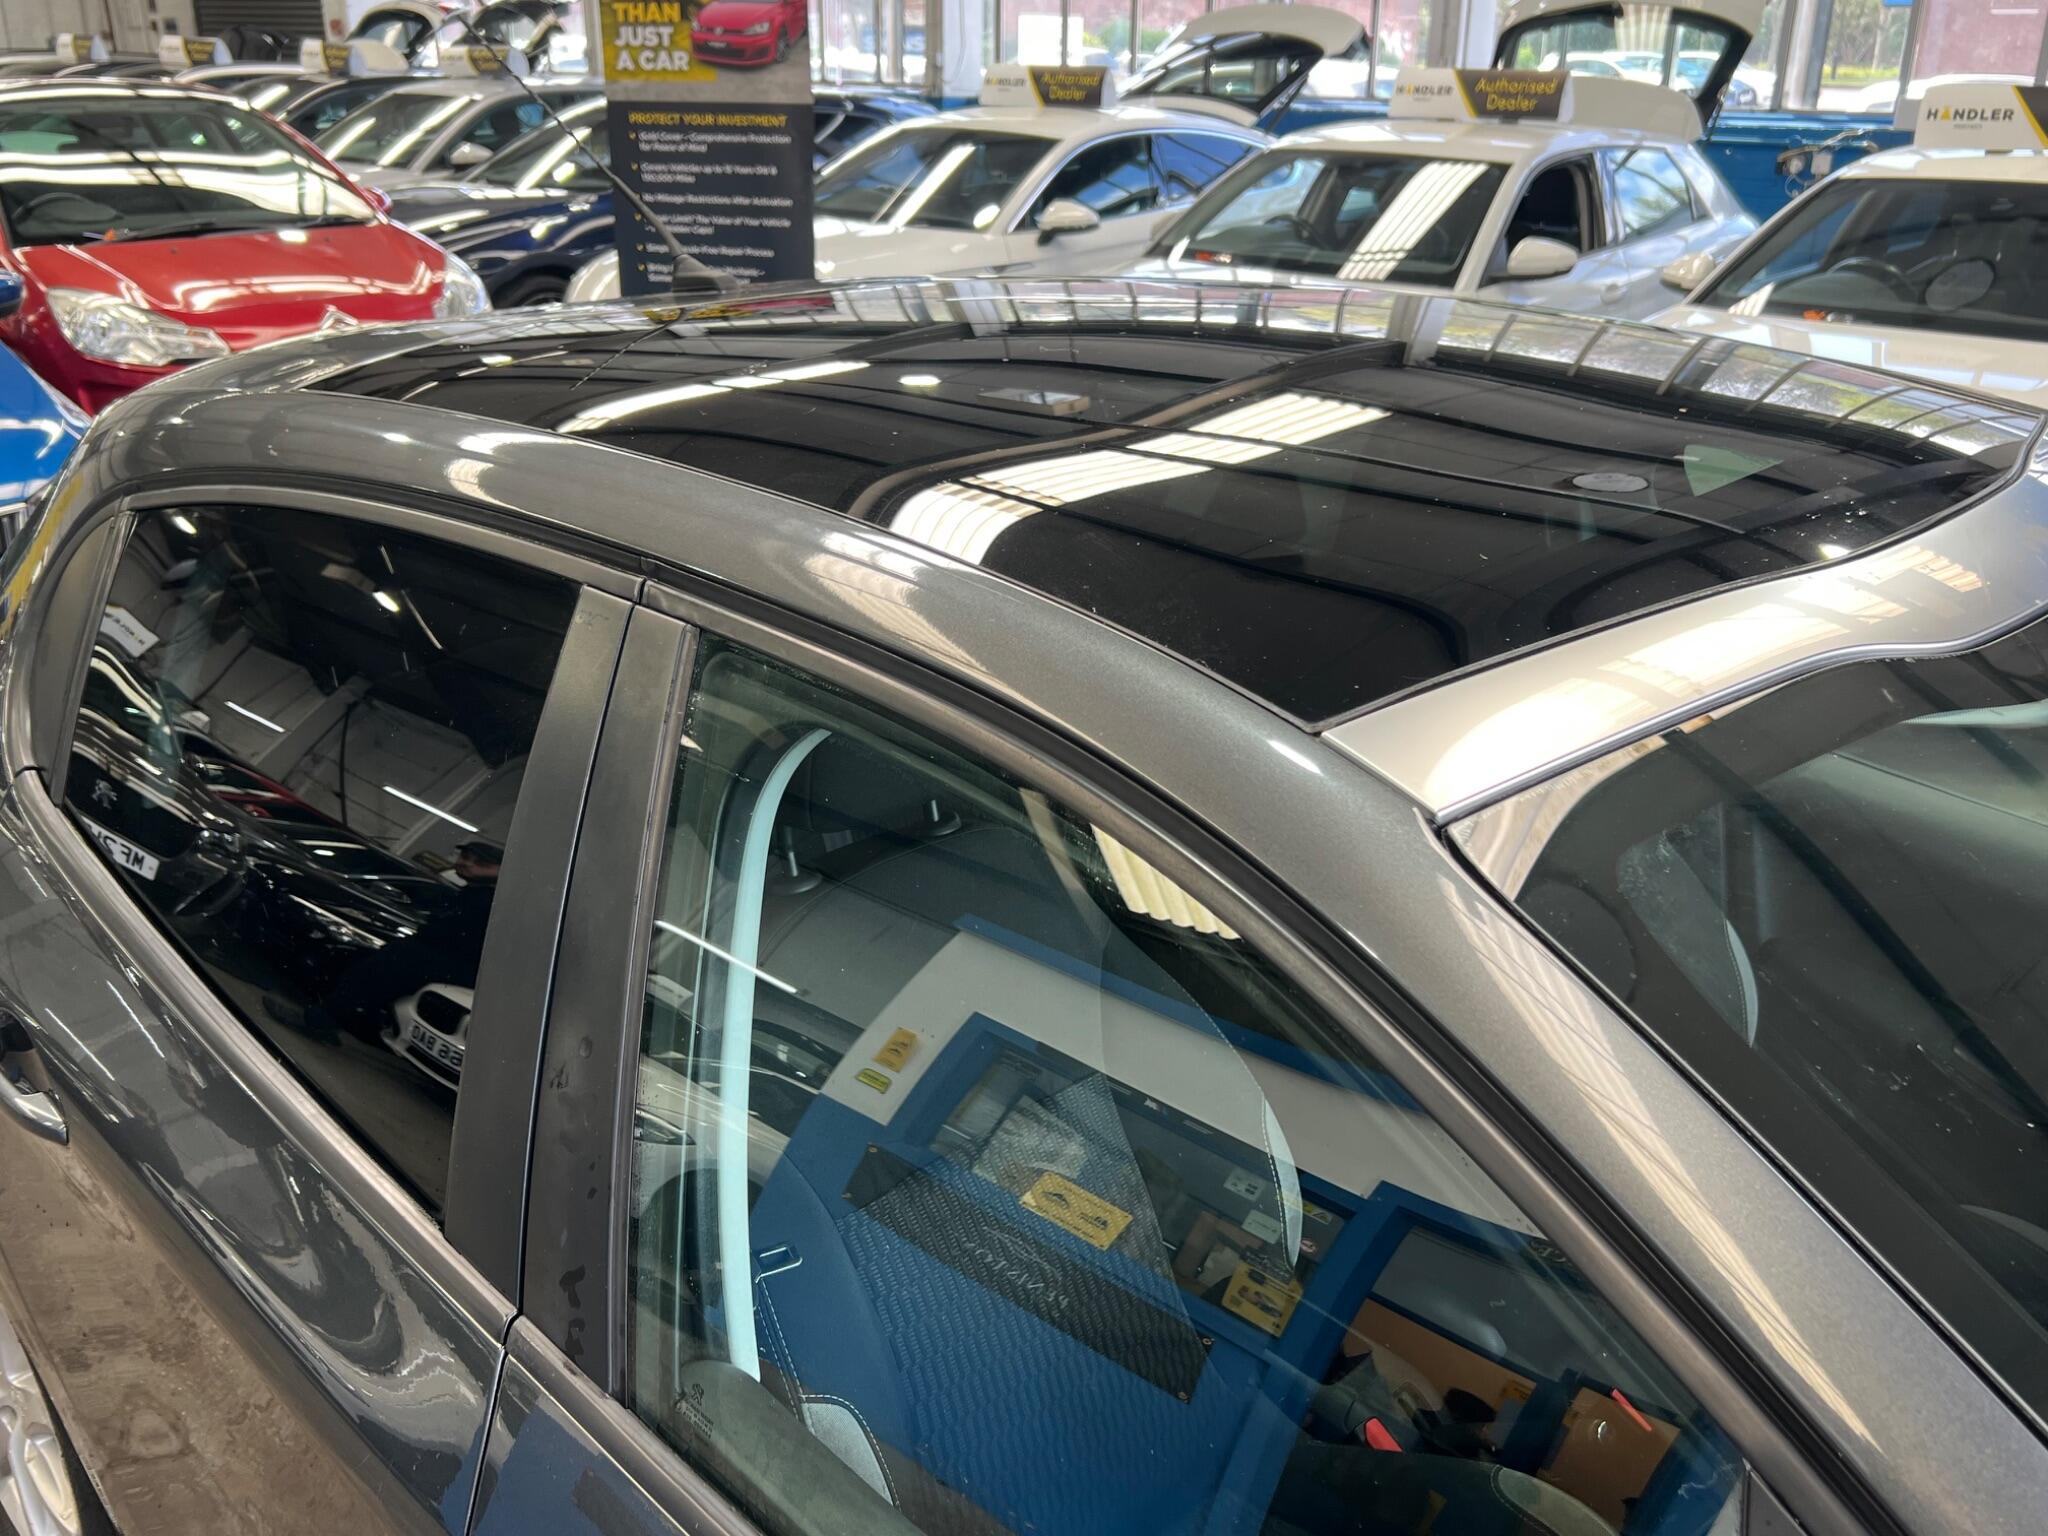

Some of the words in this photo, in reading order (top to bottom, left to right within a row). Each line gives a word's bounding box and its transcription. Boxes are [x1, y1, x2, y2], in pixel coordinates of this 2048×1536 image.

[611, 2, 681, 22] THAN
[614, 25, 674, 47] JUST
[616, 49, 635, 71] A
[639, 49, 689, 71] CAR
[1474, 77, 1559, 95] Authorised
[1486, 95, 1538, 112] Dealer
[628, 111, 681, 126] PROTECT
[683, 112, 715, 127] YOUR
[716, 113, 788, 129] INVESTMENT
